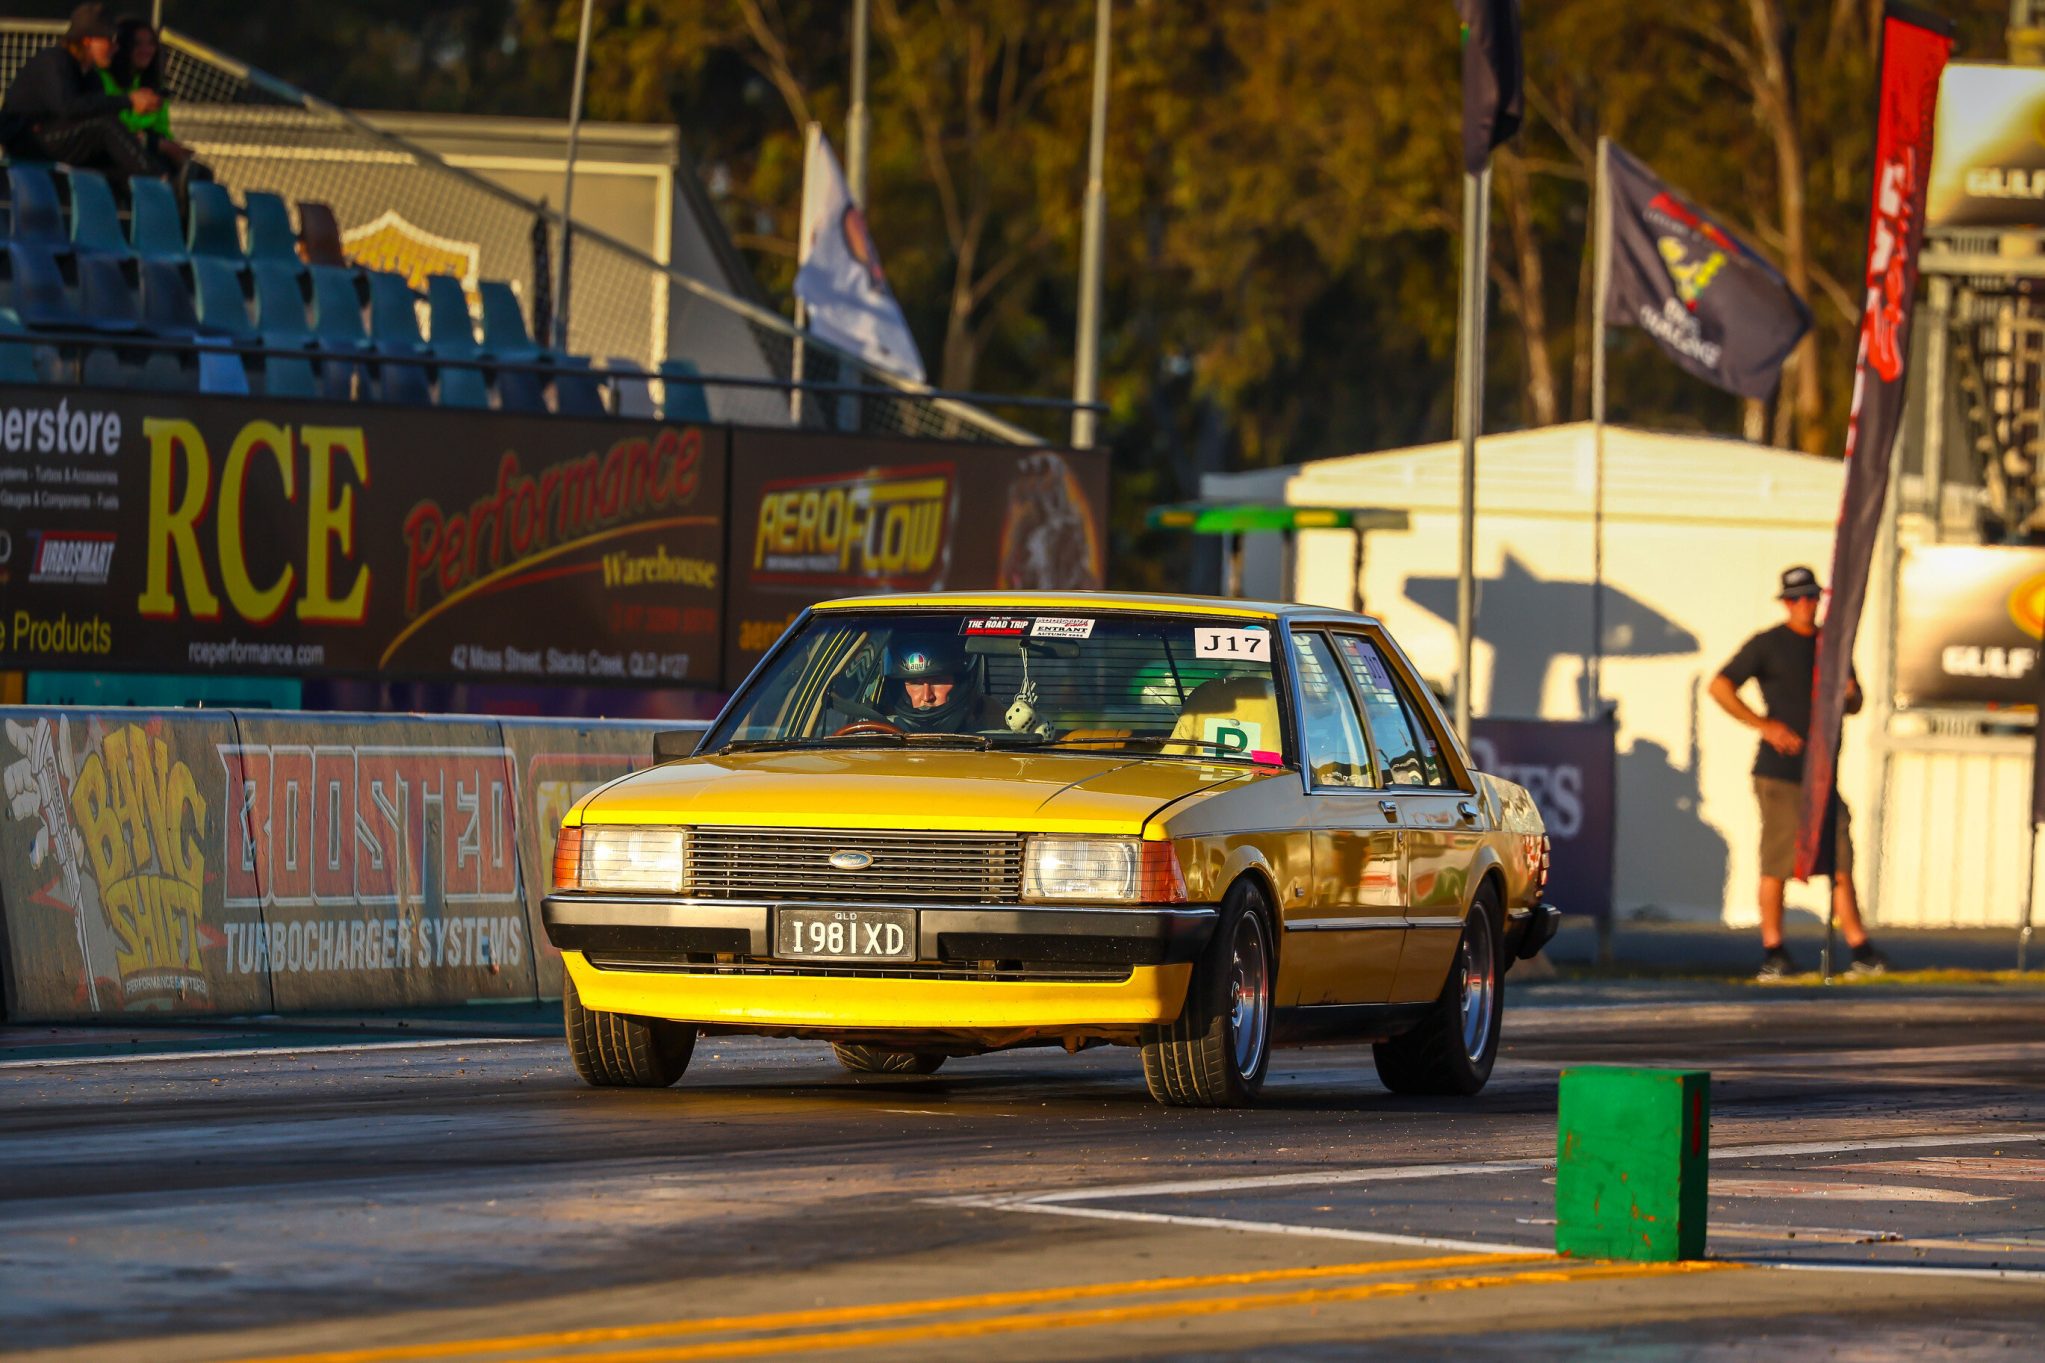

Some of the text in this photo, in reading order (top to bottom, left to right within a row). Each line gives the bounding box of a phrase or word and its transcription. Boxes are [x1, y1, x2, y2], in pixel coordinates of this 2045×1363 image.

[0, 397, 122, 456] erstore
[138, 416, 371, 626] RCE
[404, 427, 703, 617] Performance
[753, 478, 948, 573] AEROFLOW
[26, 530, 117, 575] TURBOSMART
[602, 545, 717, 589] Warehouse
[13, 610, 112, 654] Products
[967, 620, 985, 629] THE
[985, 620, 1008, 629] ROAD
[1009, 620, 1029, 629] TRIP
[1037, 626, 1088, 634] ENTRANT
[1204, 635, 1262, 654] J17
[187, 637, 326, 667] rceperformance.com
[1215, 727, 1248, 758] P
[216, 744, 522, 908] BOOSTED
[105, 875, 204, 976] SHIFT
[834, 912, 857, 921] QLD
[223, 915, 522, 975] TURBOCHARGER SYSTEMS
